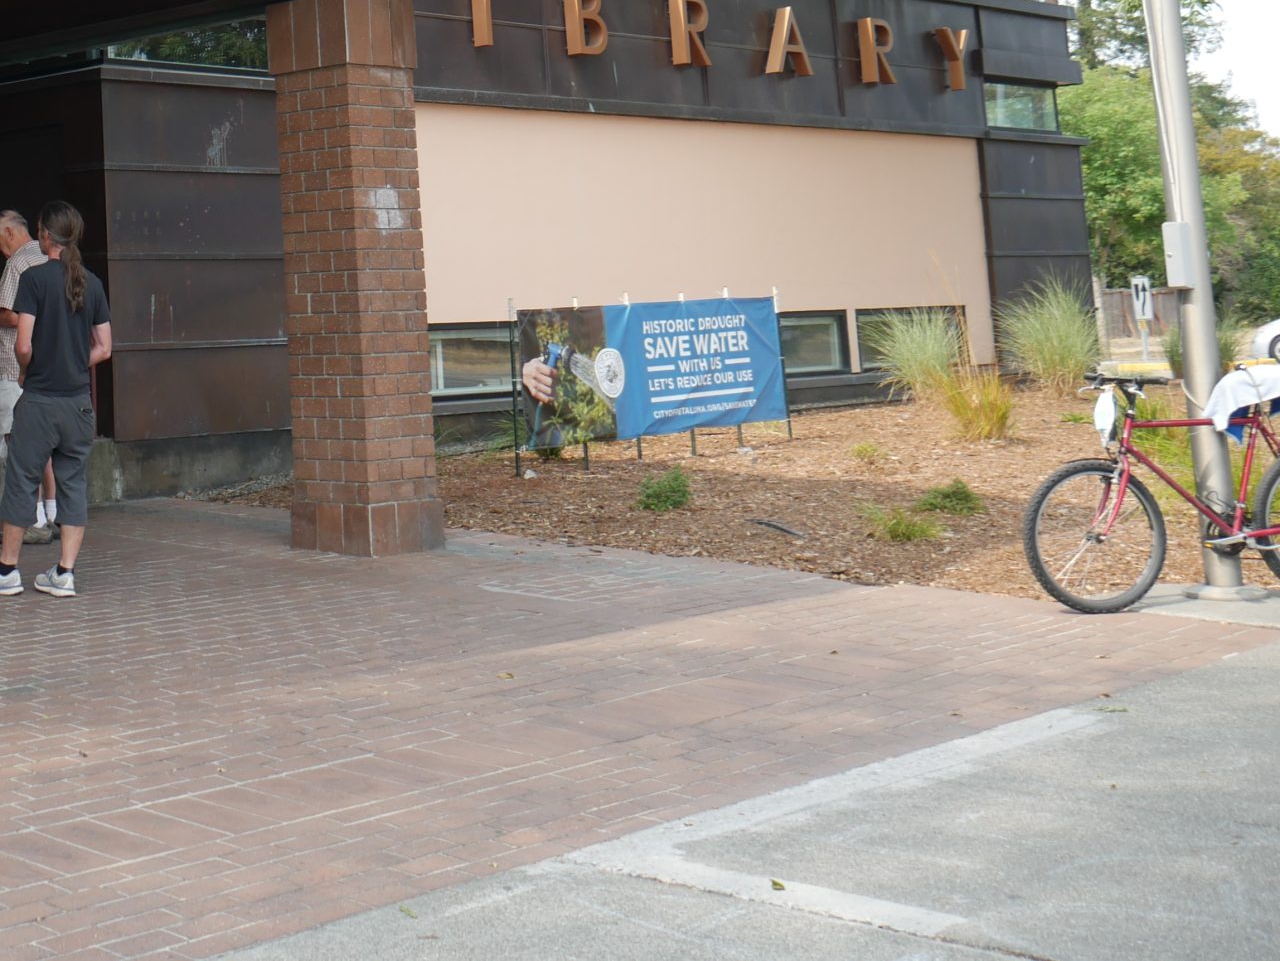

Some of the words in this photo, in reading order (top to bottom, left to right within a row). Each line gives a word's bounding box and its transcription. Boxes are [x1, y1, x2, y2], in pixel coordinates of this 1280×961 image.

[643, 319, 695, 334] HISTORIC
[644, 335, 691, 359] SAVE
[693, 331, 749, 355] WATER
[678, 358, 708, 373] WITH
[710, 357, 722, 370] US
[648, 378, 675, 391] LET'S
[677, 374, 712, 388] REDUCE
[713, 372, 734, 384] OUR
[736, 370, 753, 382] USE
